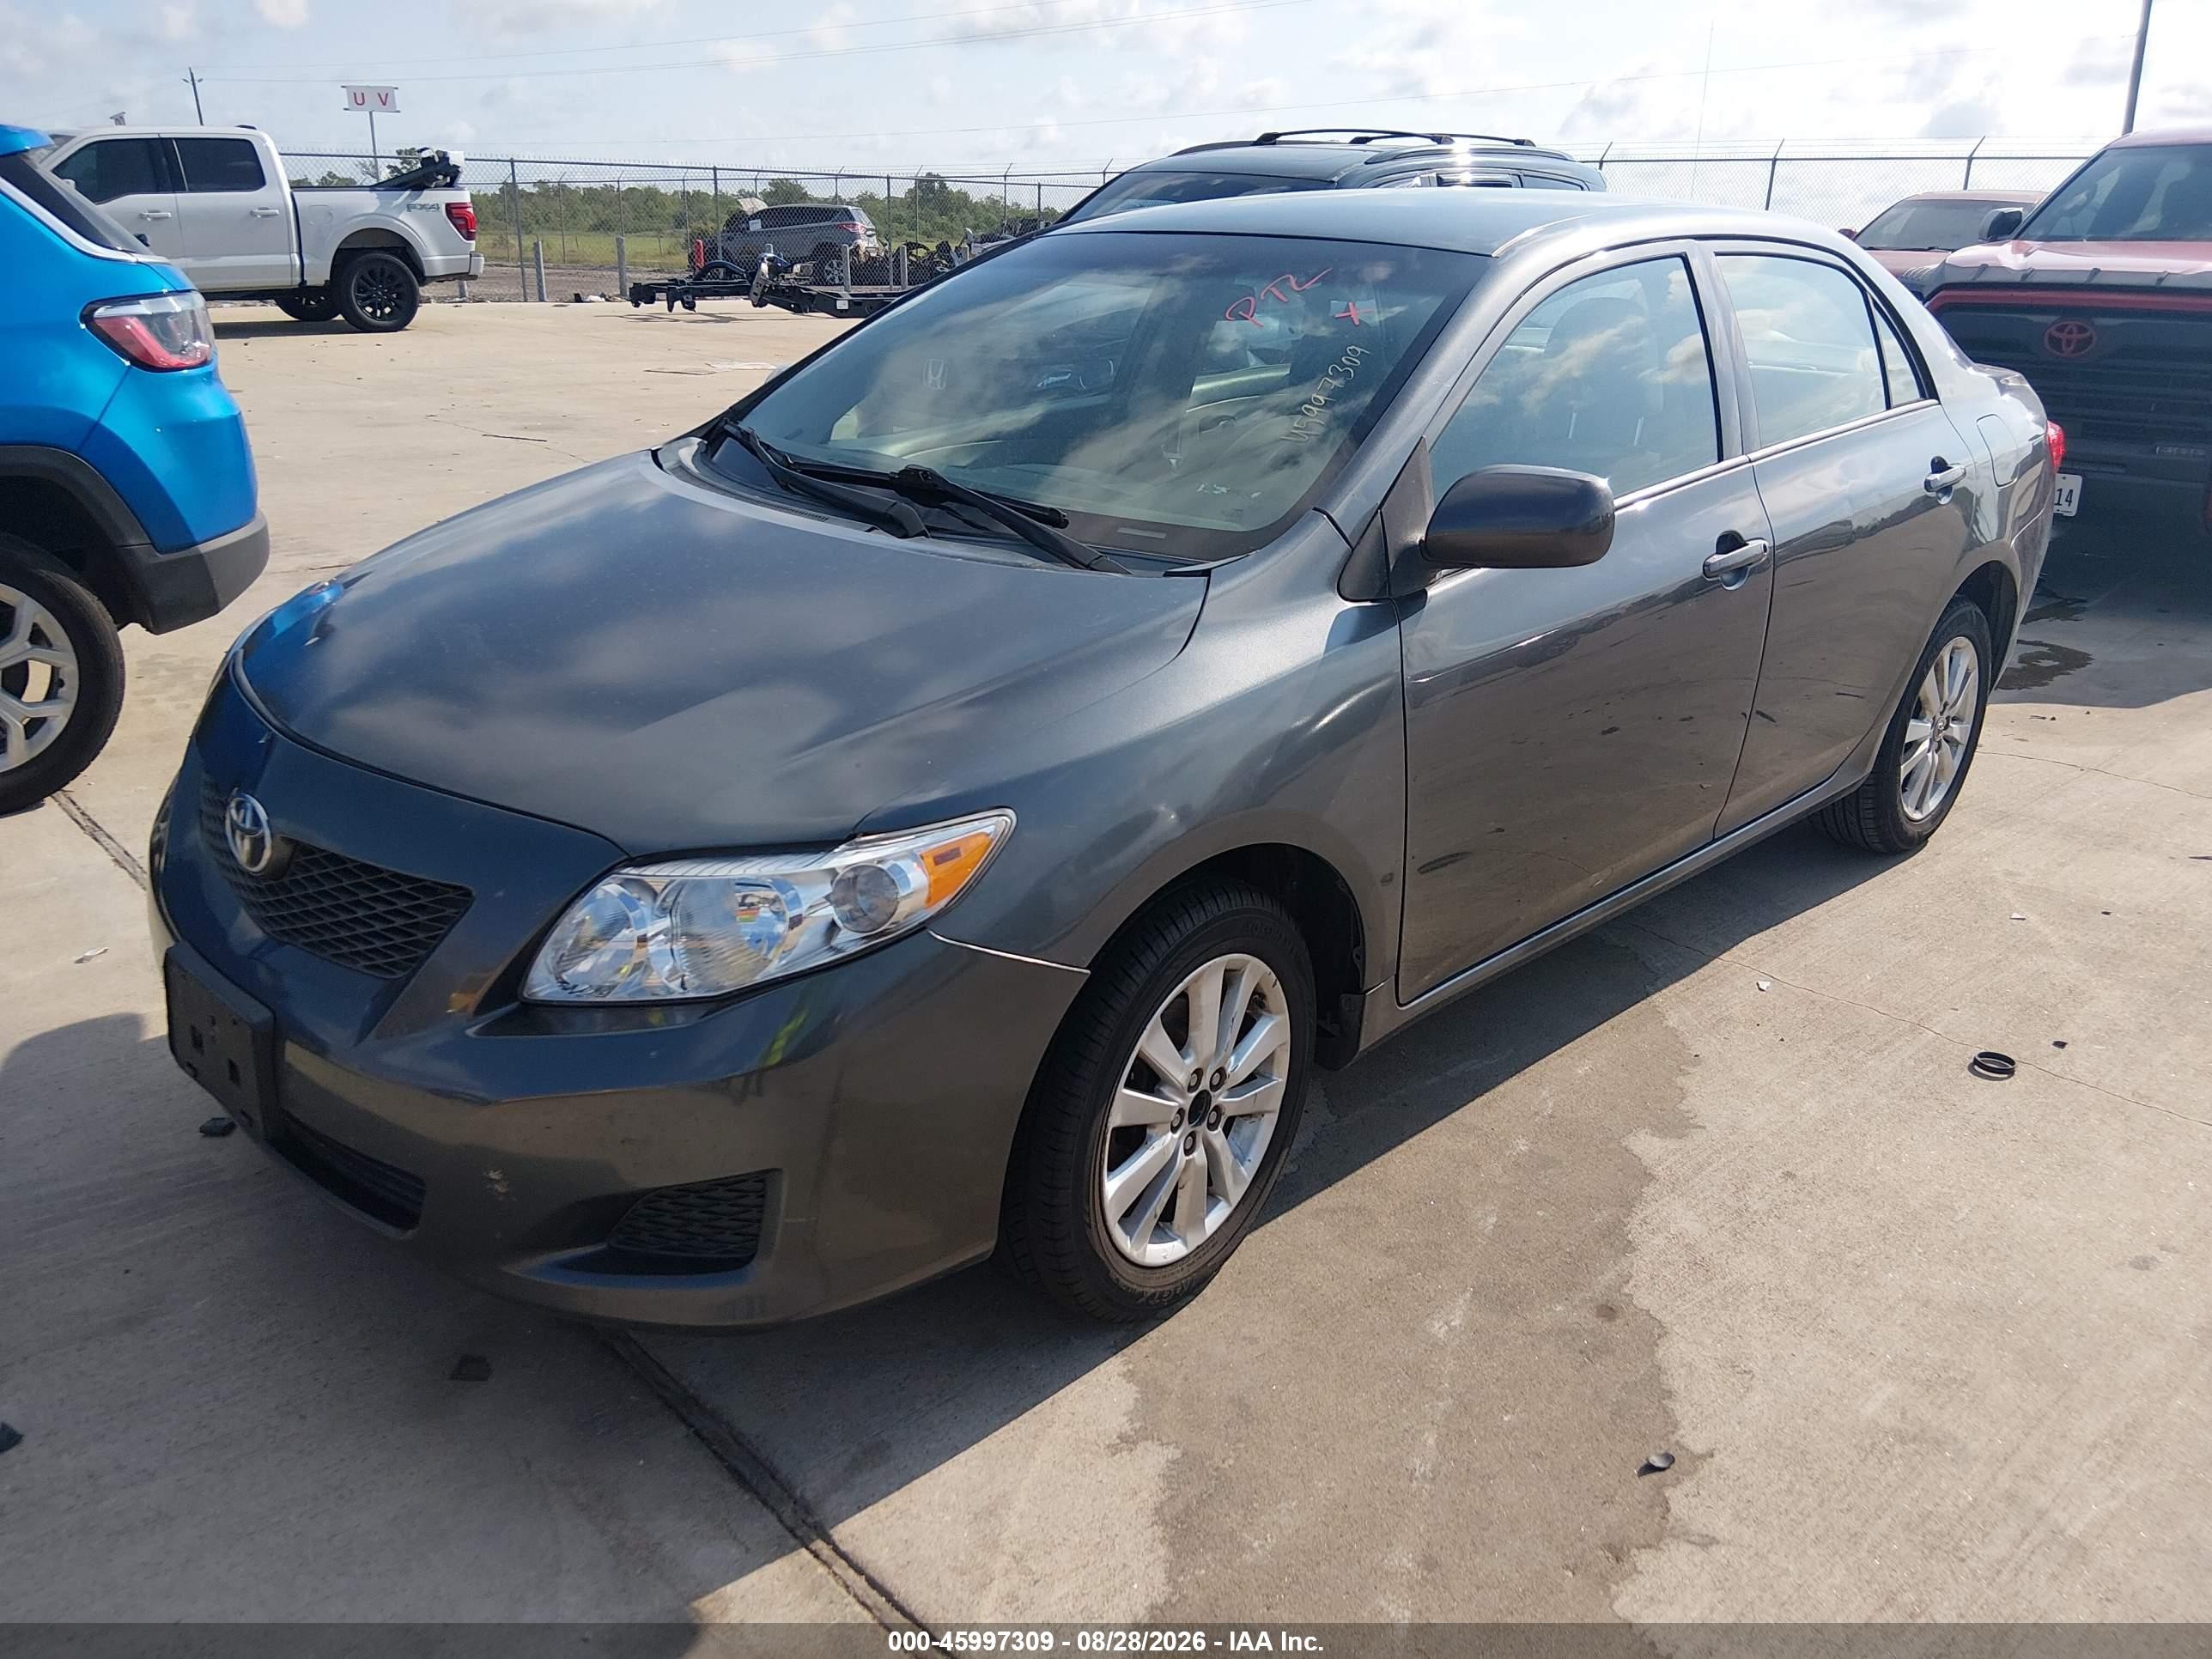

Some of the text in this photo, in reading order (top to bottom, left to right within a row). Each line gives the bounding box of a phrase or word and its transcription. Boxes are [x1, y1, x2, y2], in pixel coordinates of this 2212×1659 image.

[353, 92, 389, 106] U V
[1278, 345, 1371, 442] 45997309
[2054, 487, 2074, 507] 14
